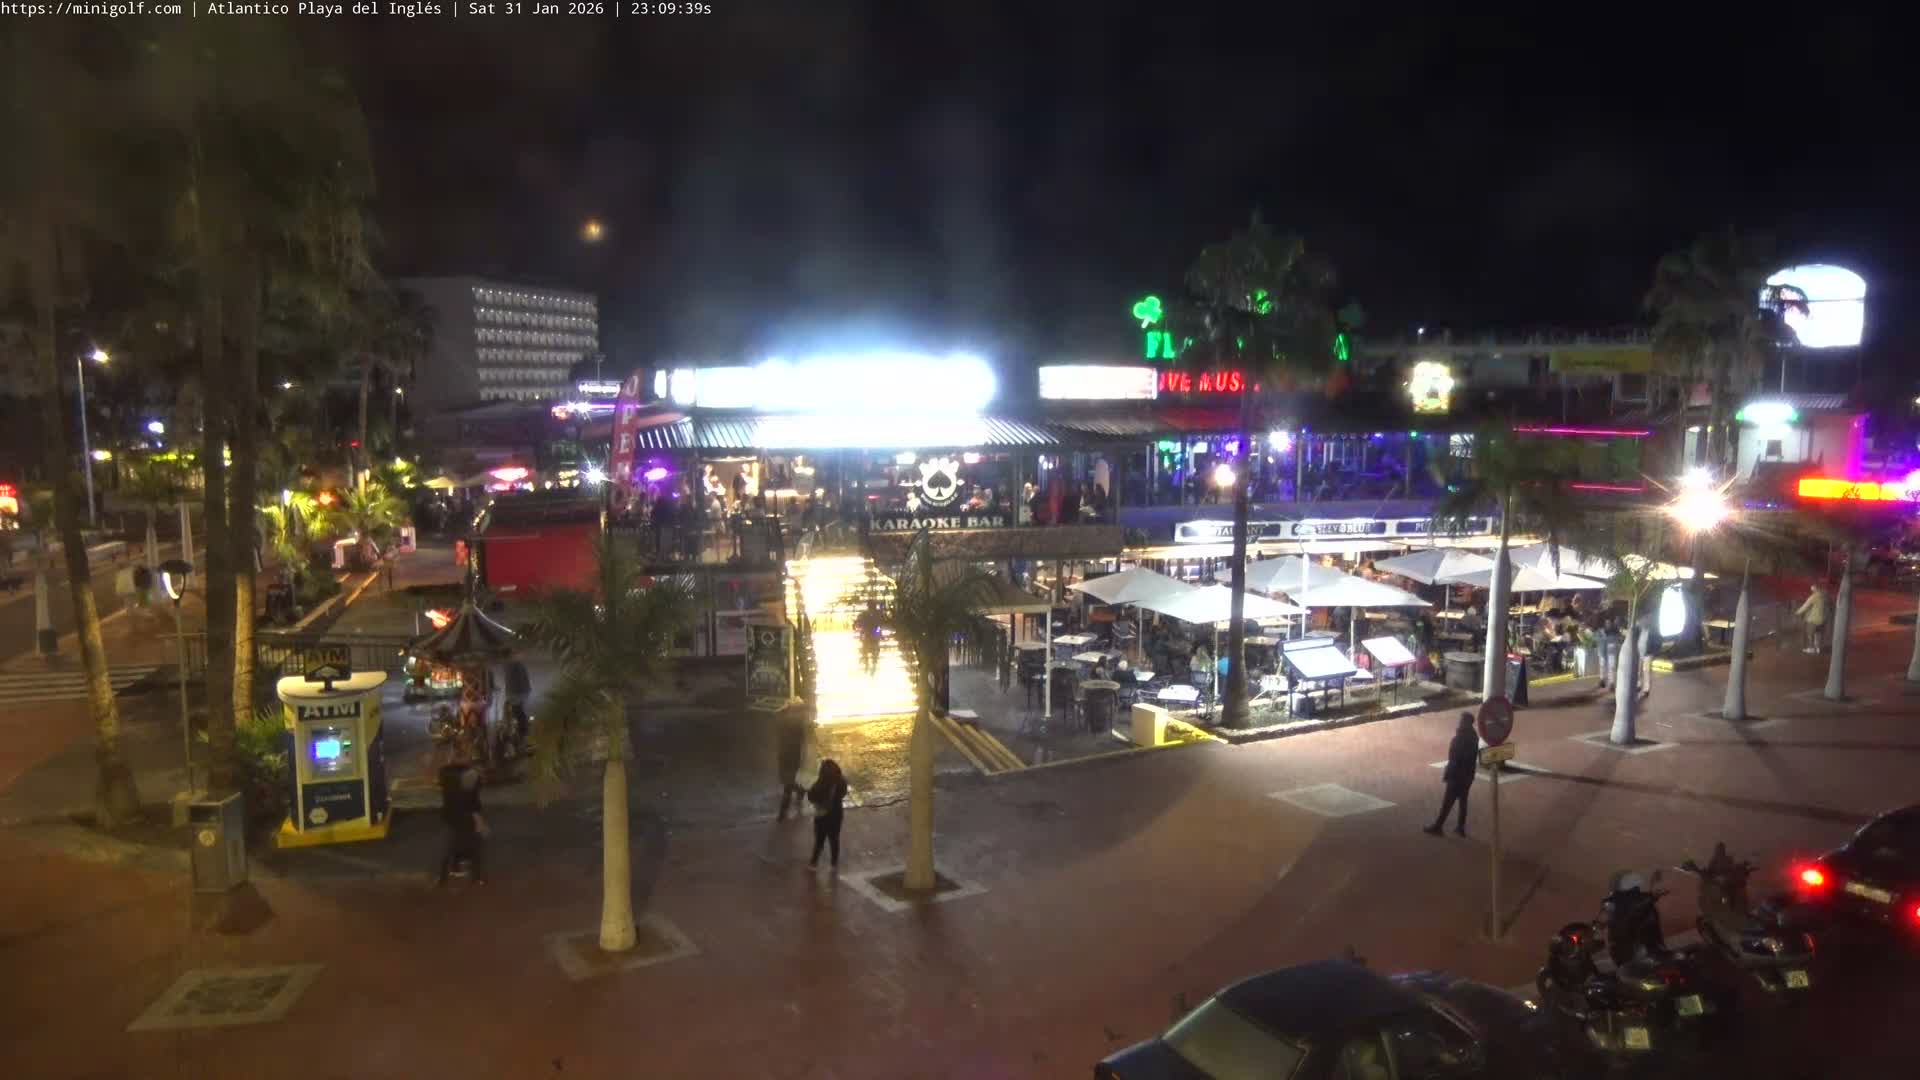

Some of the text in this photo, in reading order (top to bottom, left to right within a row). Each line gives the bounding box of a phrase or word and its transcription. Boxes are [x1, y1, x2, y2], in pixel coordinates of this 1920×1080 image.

[870, 515, 1004, 530] KARAOKE BAR
[304, 703, 356, 718] ATM
